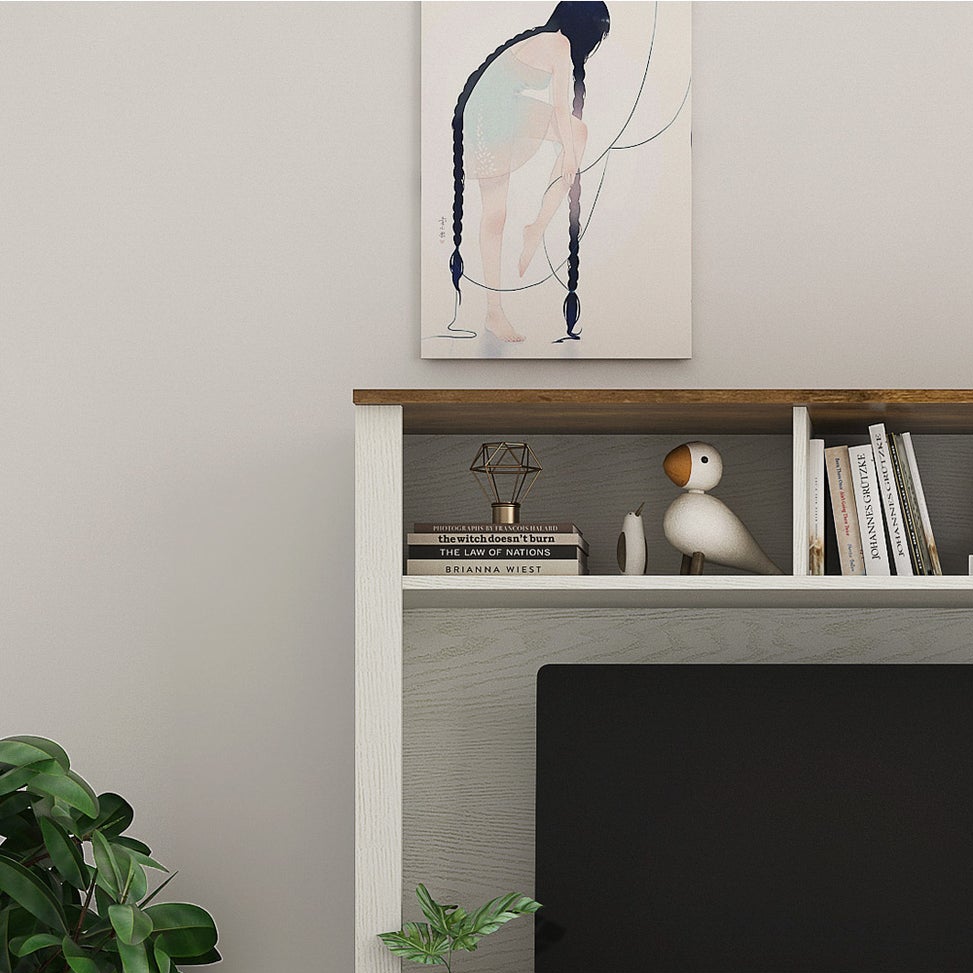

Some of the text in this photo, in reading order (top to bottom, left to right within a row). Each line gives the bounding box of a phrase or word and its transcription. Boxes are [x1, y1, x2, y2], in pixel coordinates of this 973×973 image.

[438, 534, 456, 543] the
[457, 534, 488, 543] witch
[530, 534, 555, 543] burn
[864, 504, 881, 560] JOHANNES
